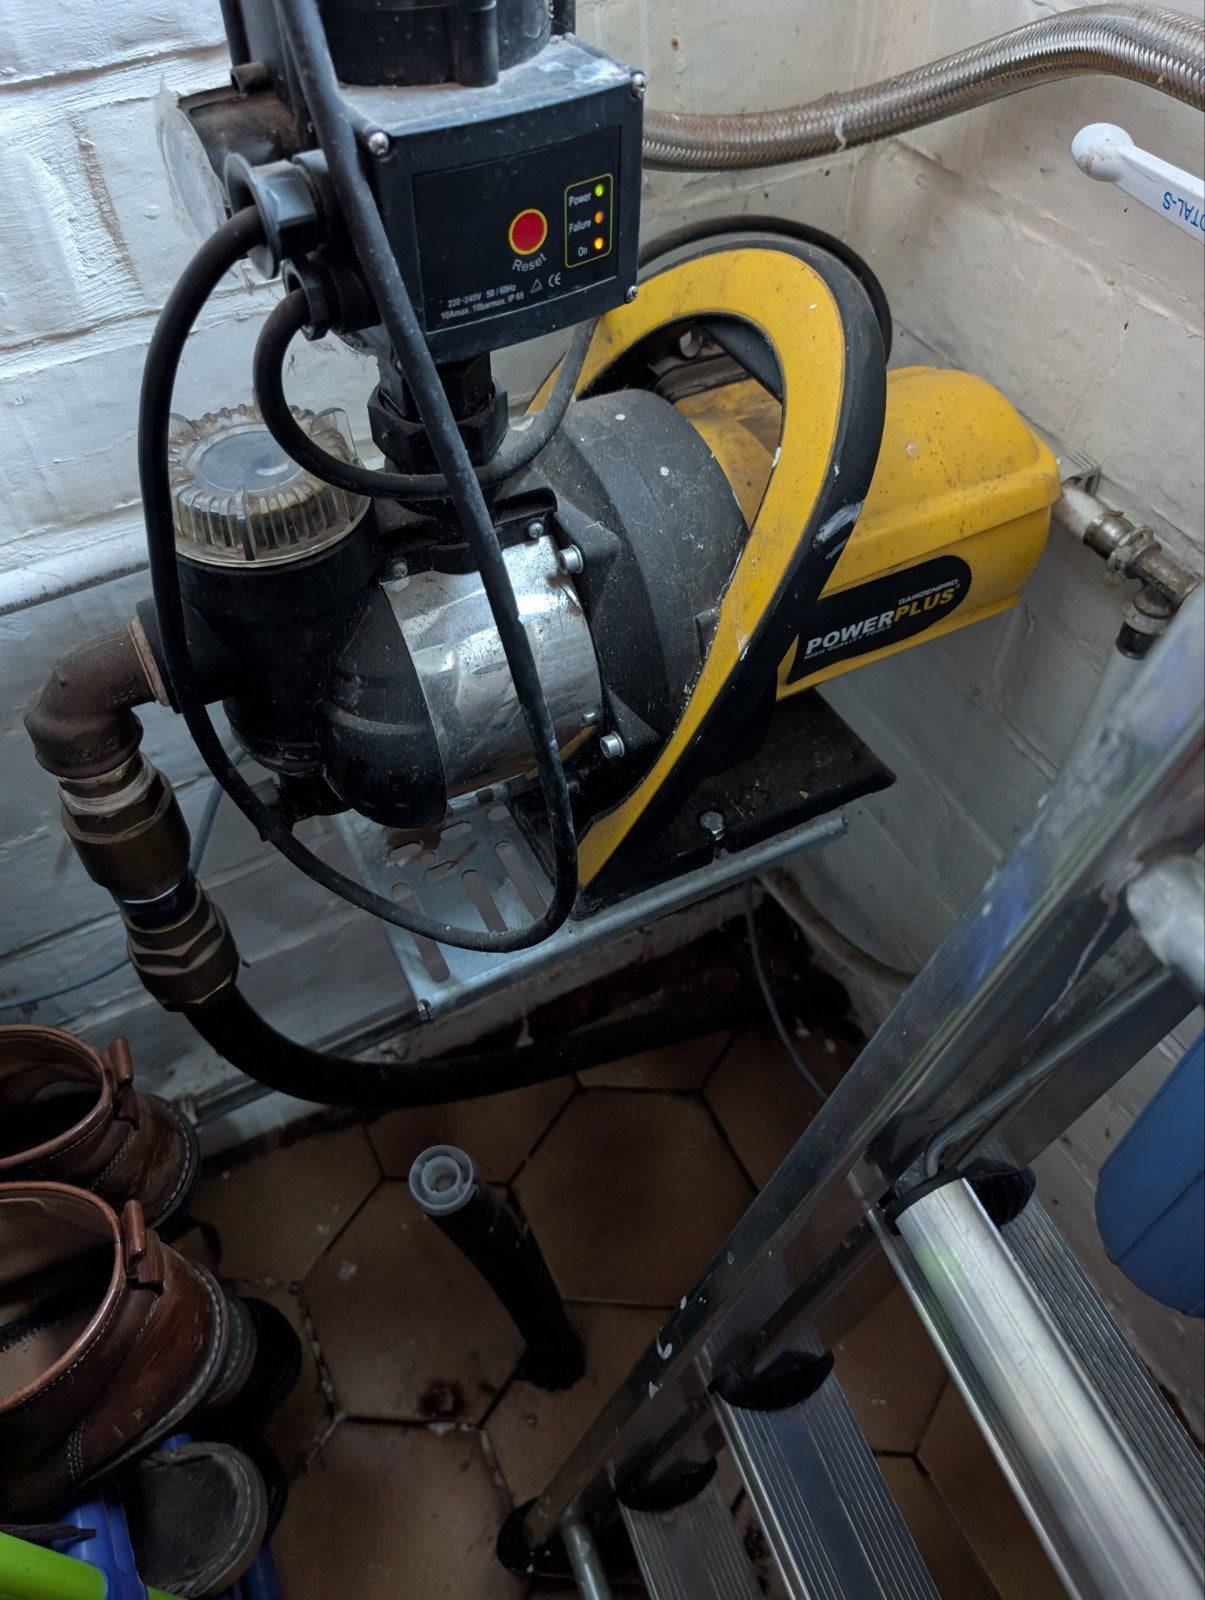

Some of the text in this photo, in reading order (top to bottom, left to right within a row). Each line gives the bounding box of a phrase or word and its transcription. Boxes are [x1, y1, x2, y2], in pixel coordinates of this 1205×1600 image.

[568, 193, 592, 207] Power
[567, 220, 592, 235] Failure
[577, 246, 588, 257] On
[512, 253, 547, 272] Reset
[805, 588, 955, 655] POWERPLUS
